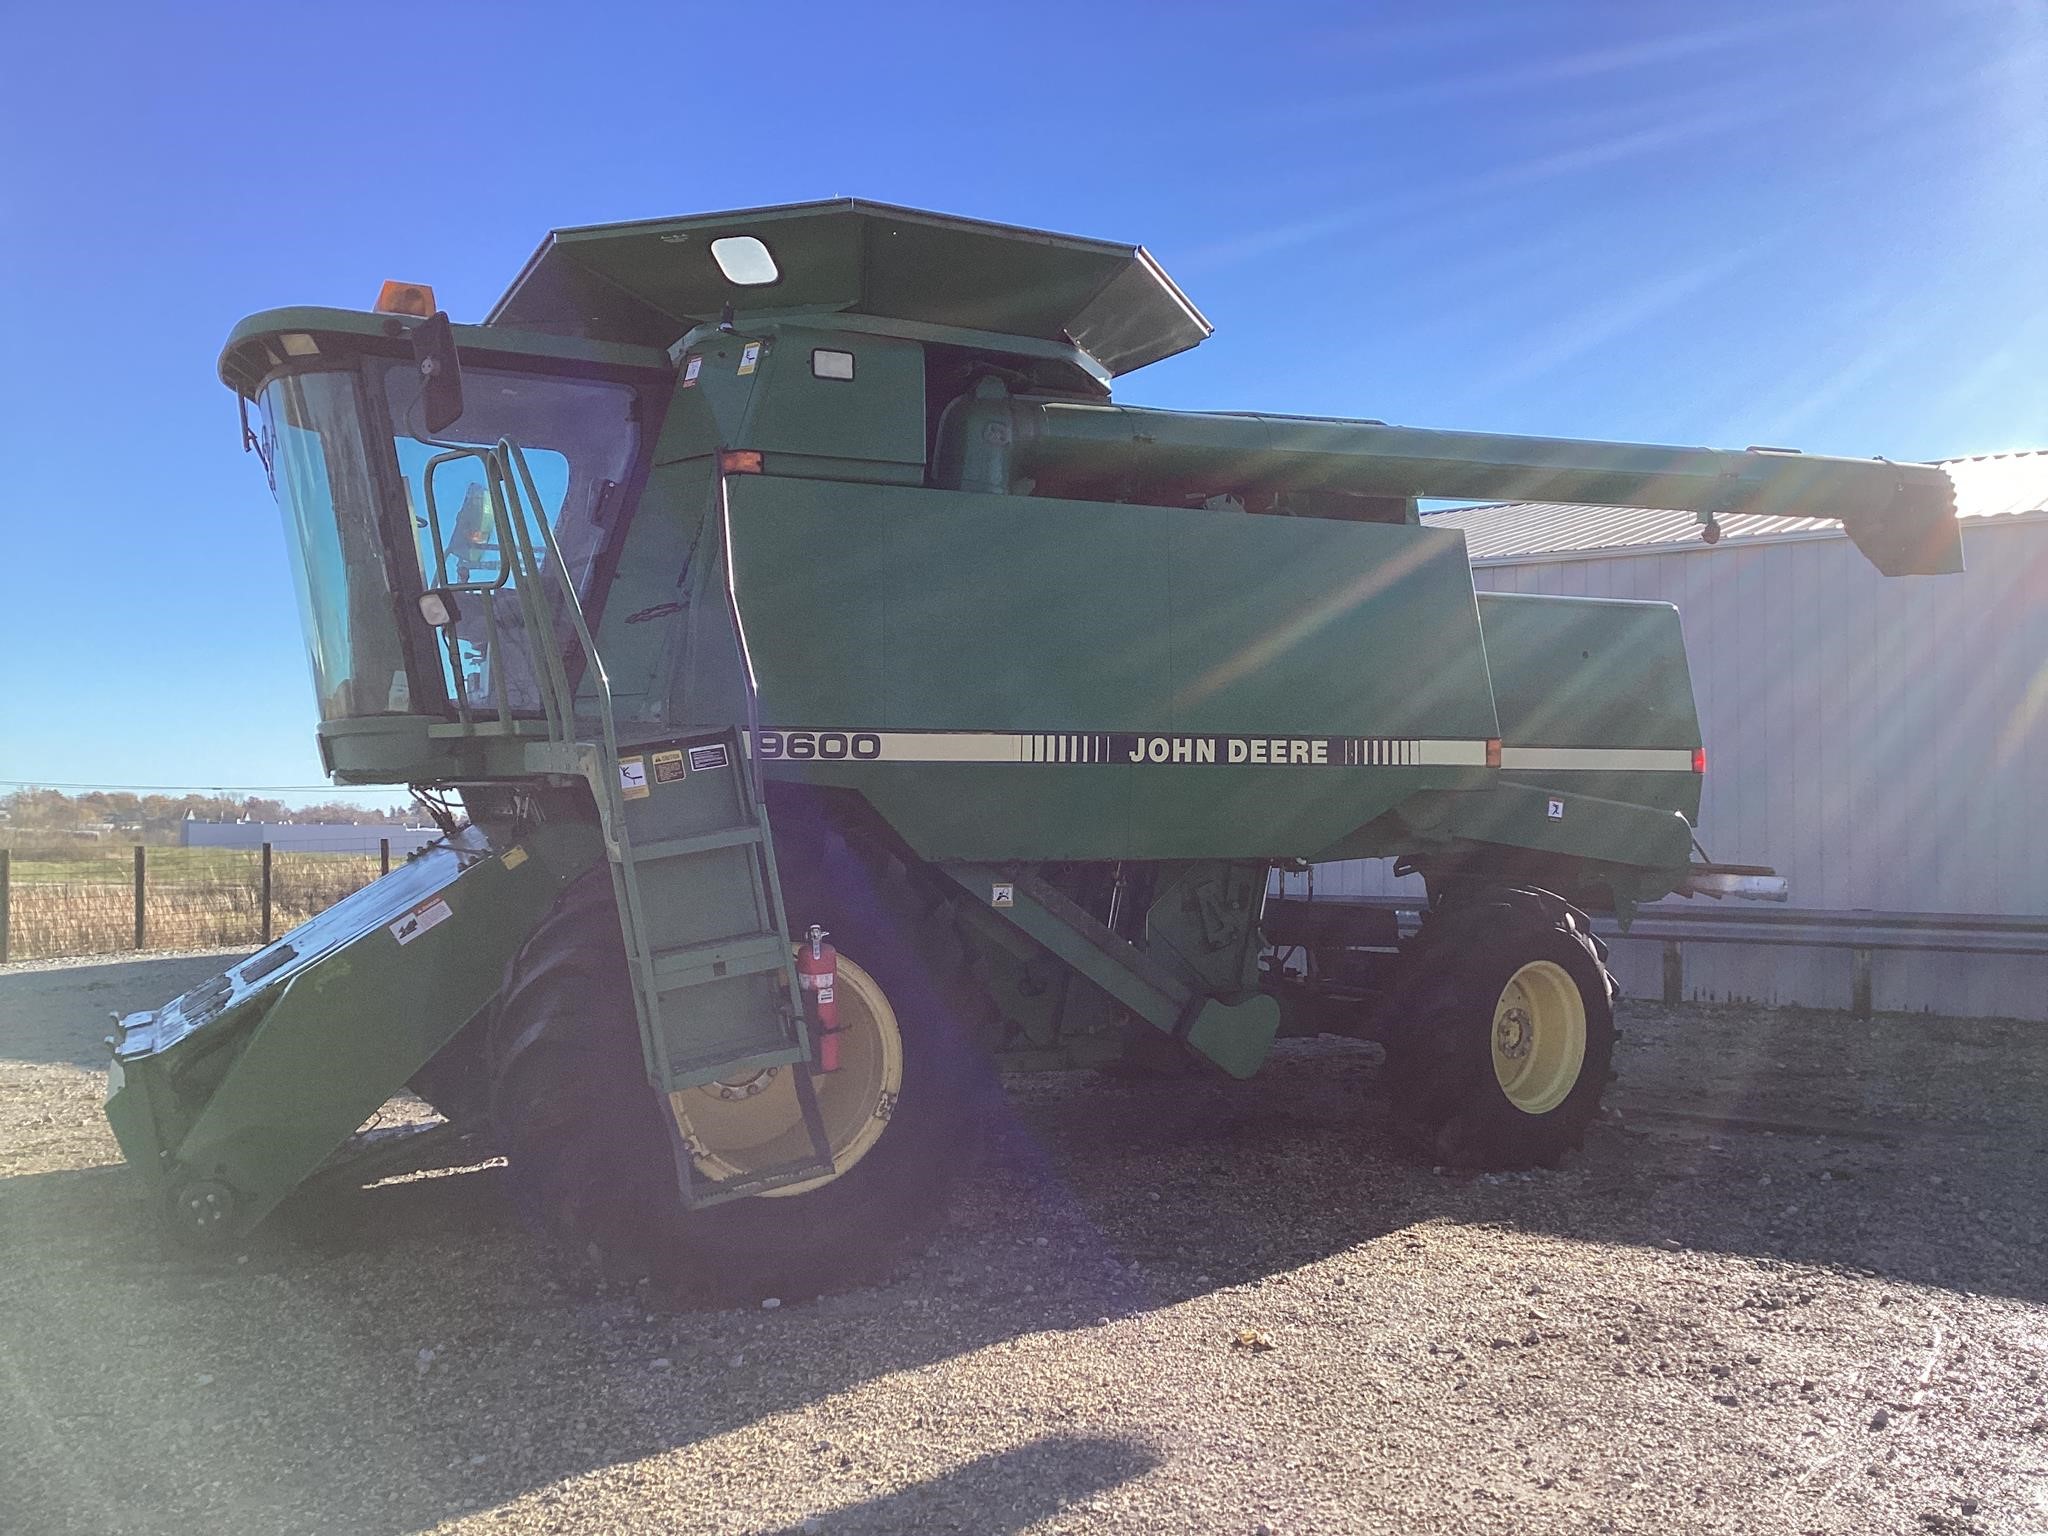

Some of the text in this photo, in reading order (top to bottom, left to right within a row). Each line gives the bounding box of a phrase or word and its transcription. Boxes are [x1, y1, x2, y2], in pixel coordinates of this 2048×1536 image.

[758, 733, 881, 759] 9600
[1129, 737, 1328, 764] JOHN DEERE
